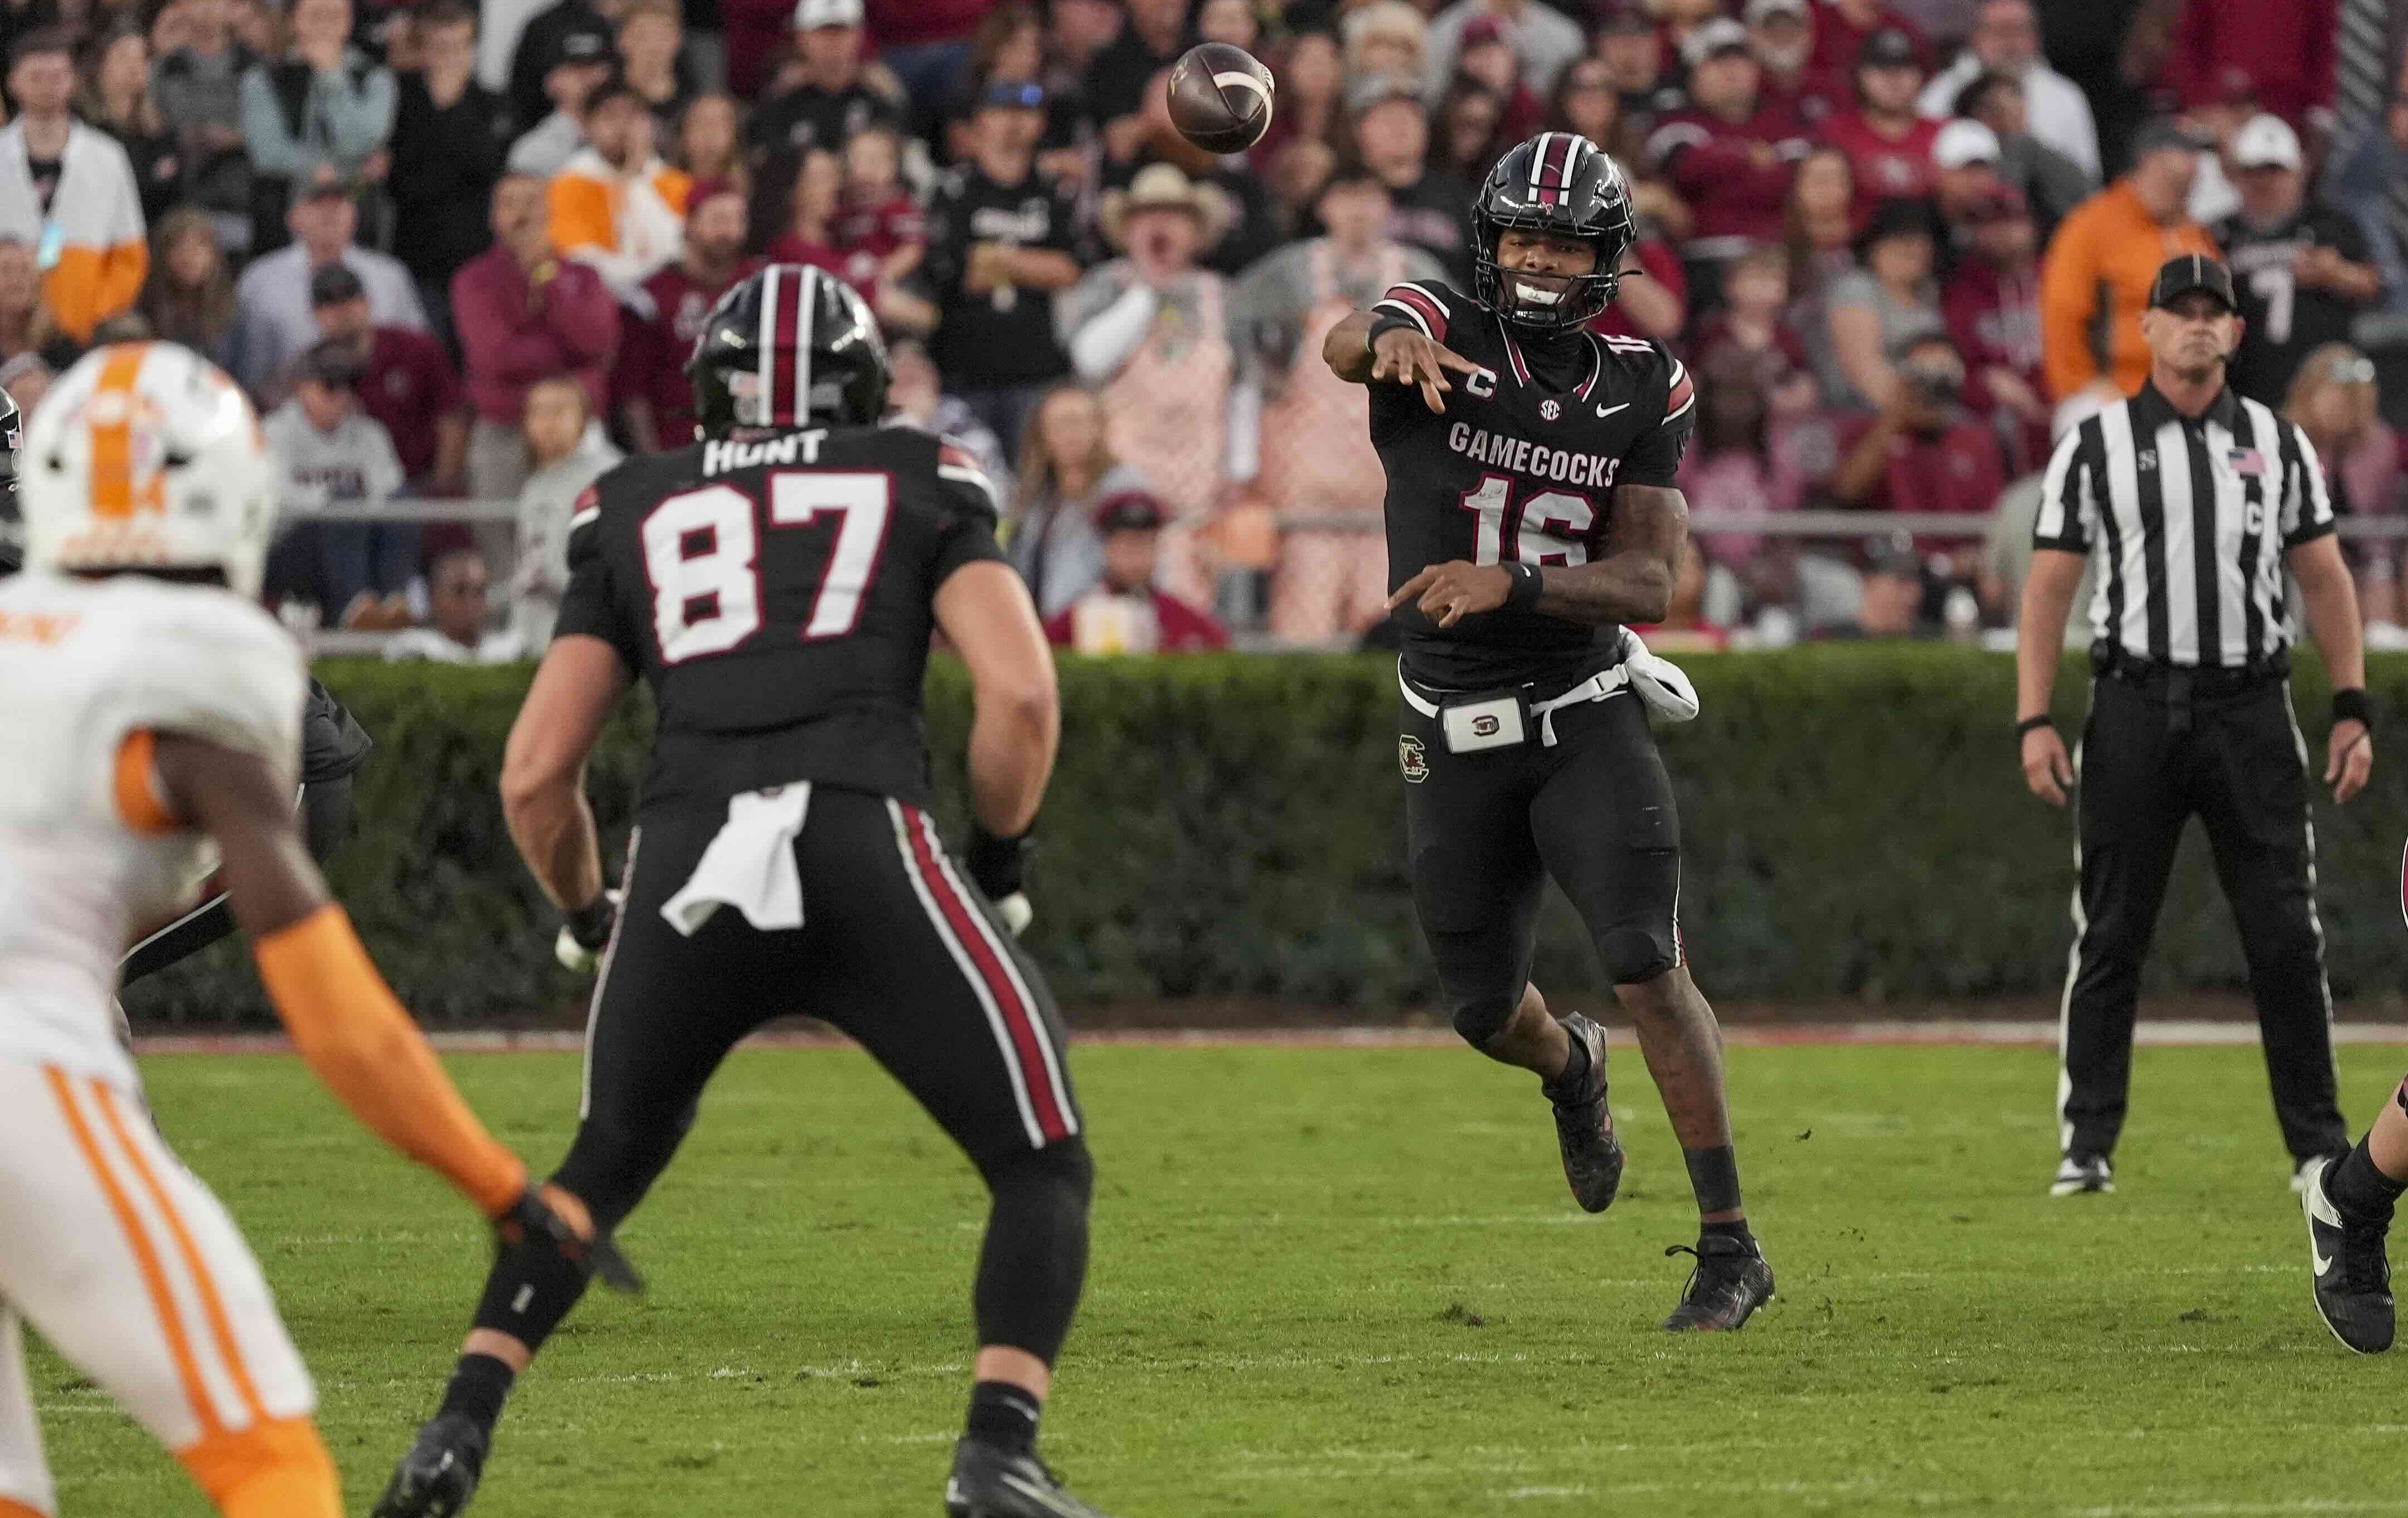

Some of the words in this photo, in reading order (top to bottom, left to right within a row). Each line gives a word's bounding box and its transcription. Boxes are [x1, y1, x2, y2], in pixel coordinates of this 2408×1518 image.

[1465, 366, 1498, 398] C
[1540, 399, 1560, 420] SEC
[702, 428, 829, 477] HUNT
[1449, 421, 1620, 487] GAMECOCKS
[1459, 472, 1596, 567] 16
[640, 470, 892, 663] 87
